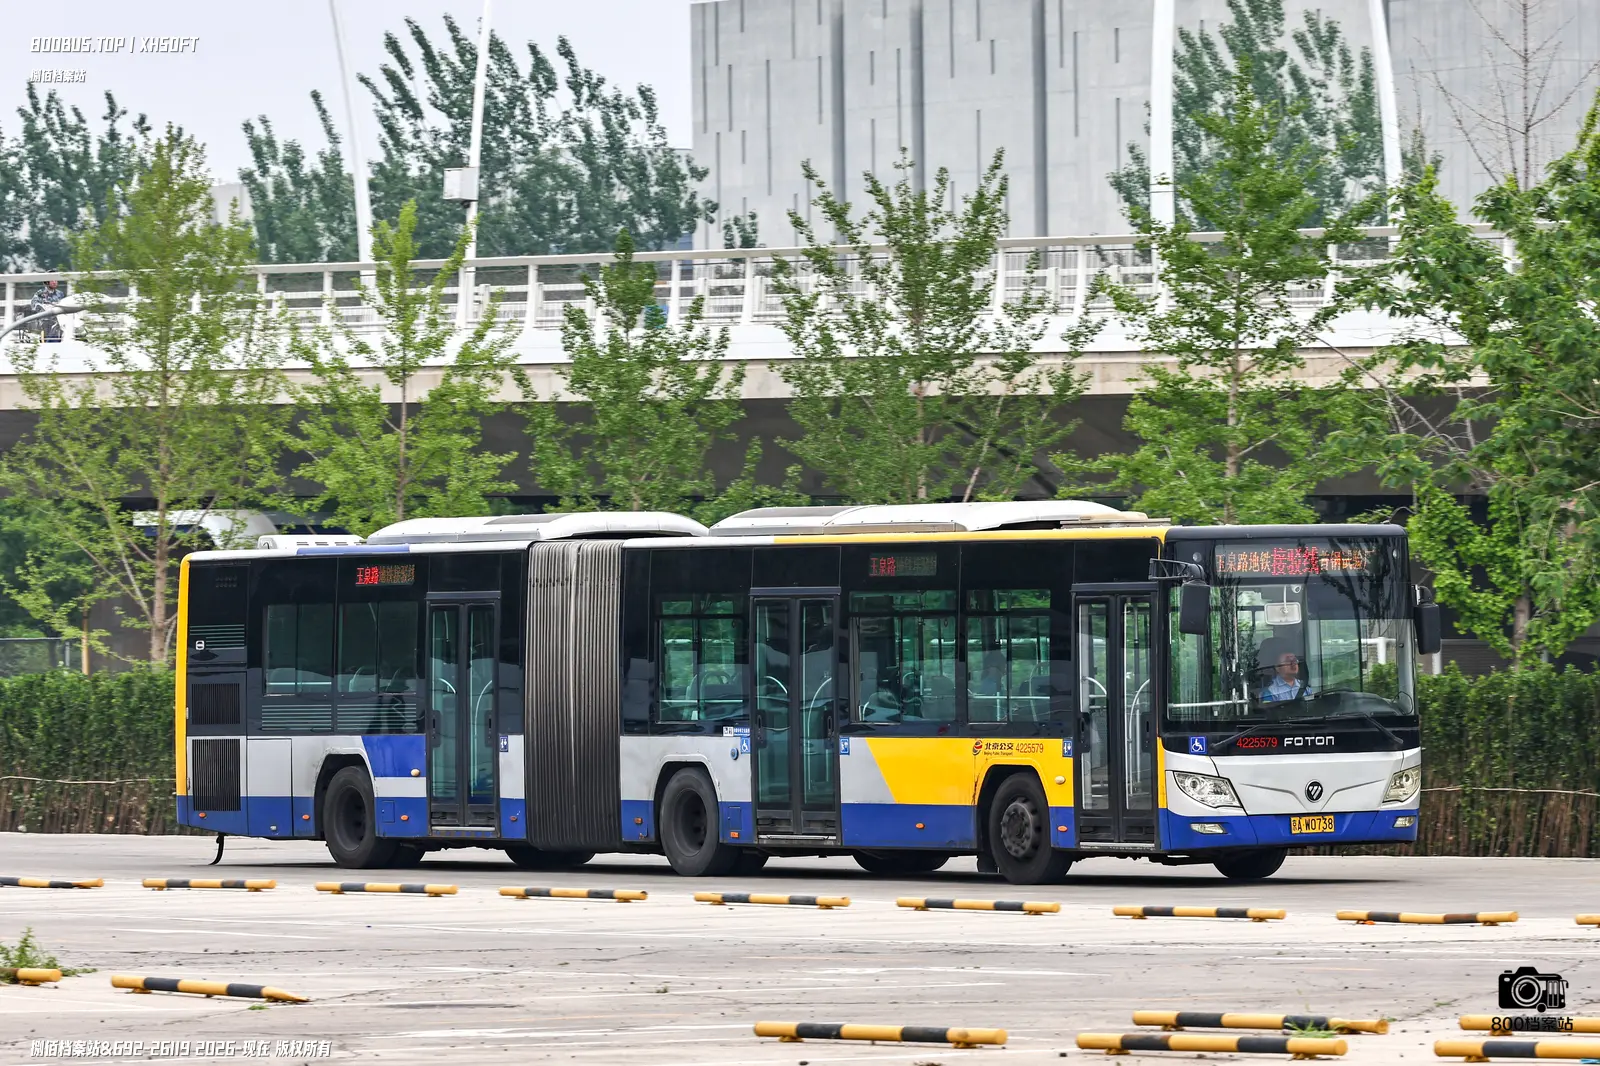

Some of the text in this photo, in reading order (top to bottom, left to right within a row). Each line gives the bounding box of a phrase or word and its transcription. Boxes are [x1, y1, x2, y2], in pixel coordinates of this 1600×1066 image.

[985, 742, 1044, 753] 北京公交 4225579
[1236, 736, 1335, 748] 4225579 FOTON
